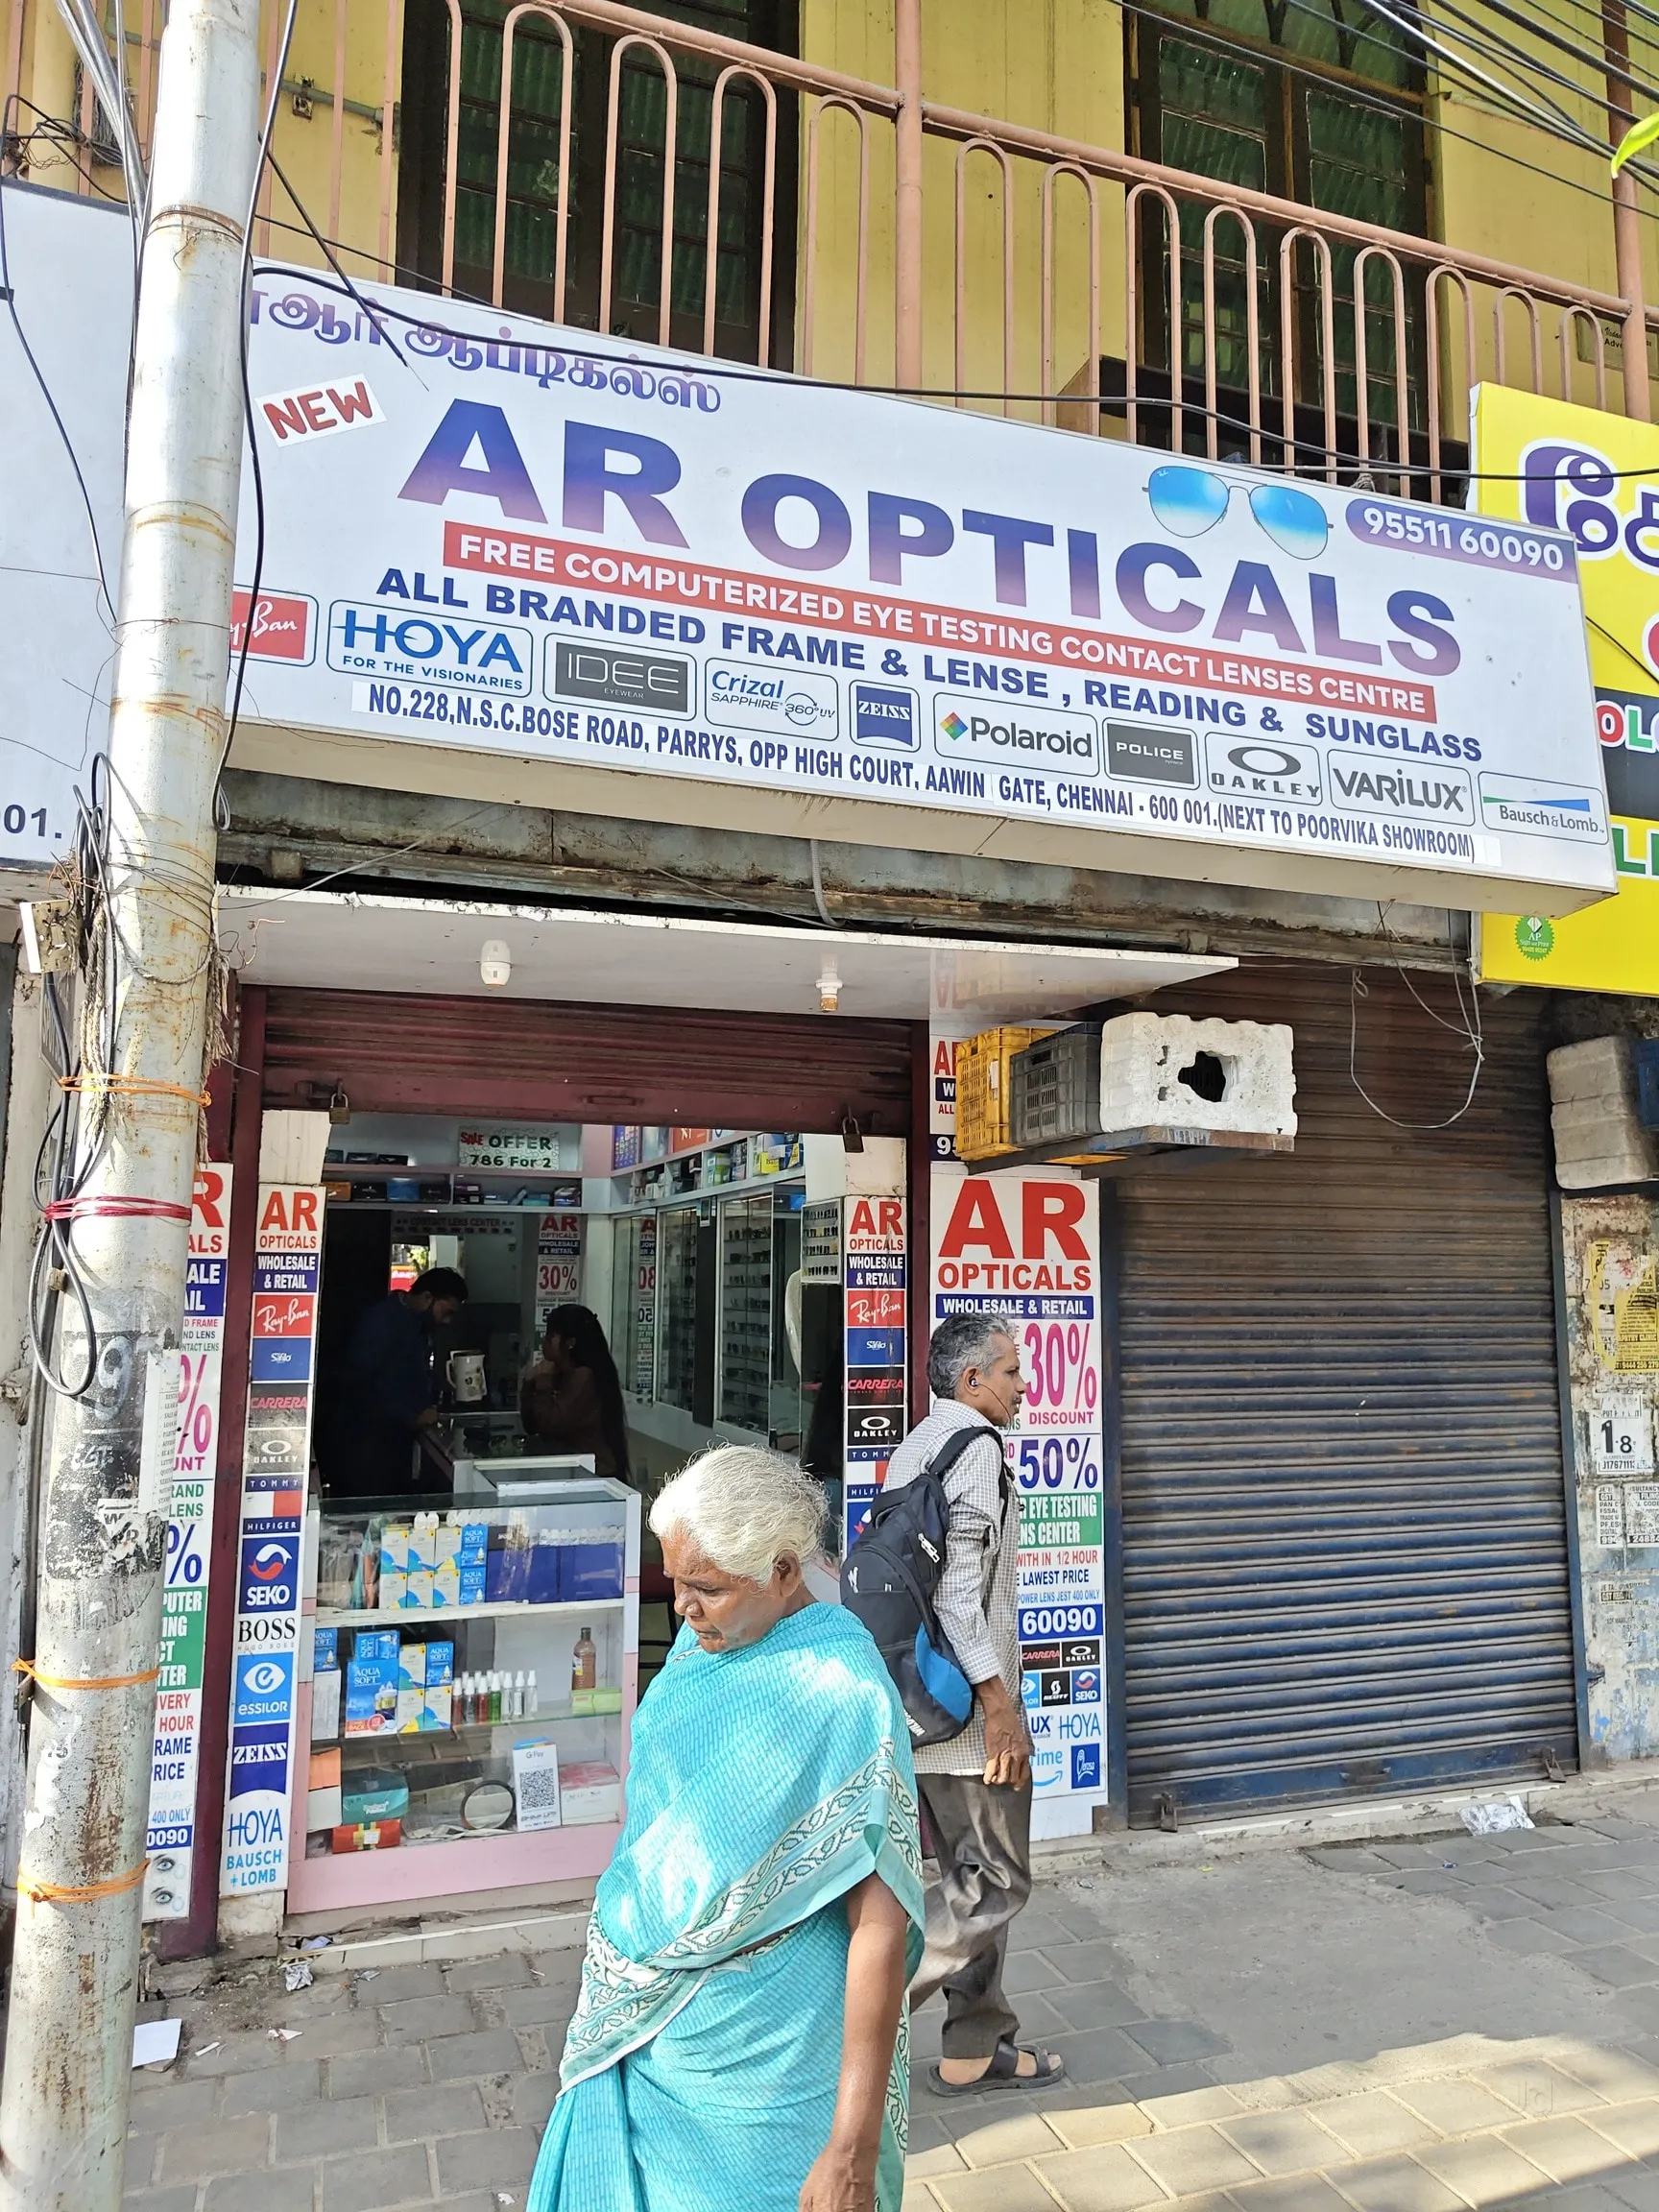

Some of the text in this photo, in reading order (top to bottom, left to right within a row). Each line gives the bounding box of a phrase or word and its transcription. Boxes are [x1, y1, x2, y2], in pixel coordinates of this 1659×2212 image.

[251, 291, 389, 345] ஆர்
[263, 380, 373, 441] NEW
[397, 397, 689, 549] AR
[742, 472, 1460, 676] OPTICALS
[1362, 506, 1563, 571] 95511 60090
[461, 534, 1426, 714] FREE COMPUTERIZED EYE TESTING CONTACT LENSES CENTRE
[331, 609, 524, 674] HOYA
[343, 655, 523, 690] FOR THE VISIONARIES
[376, 566, 469, 610] ALL
[486, 584, 706, 645] BRANDED
[722, 623, 866, 670] FRAME
[880, 648, 910, 678] &
[924, 655, 1049, 700] LENSE
[1084, 679, 1247, 727] READING
[1260, 707, 1284, 733] &
[1306, 713, 1481, 761] SUNGLASS
[566, 652, 680, 695] IDEE
[604, 686, 645, 700] EYEWEAR
[711, 670, 784, 699] Crizal
[710, 692, 780, 710] SAPPHIRE
[857, 701, 911, 722] ZEISS
[971, 716, 1093, 758] Polaroid
[1116, 741, 1184, 760] POLICE
[587, 714, 650, 753] ROAD,
[657, 726, 742, 767] PARRYS,
[750, 742, 788, 771] OPP
[796, 747, 843, 780] HIGH
[850, 754, 920, 791] COURT,
[926, 766, 985, 799] AAWIN
[998, 776, 1052, 811] GATE,
[1057, 782, 1134, 817] CHENNAI
[1149, 792, 1179, 823] 600
[1272, 808, 1293, 835] TO
[1297, 811, 1378, 847] POORVIKA
[1382, 824, 1476, 864] SHOWROOM)
[1211, 772, 1320, 799] OAKLEY
[488, 1135, 552, 1151] OFFER
[469, 1154, 552, 1168] 786 For 2
[260, 1191, 318, 1232] AR
[849, 1200, 903, 1236] AR
[938, 1179, 1092, 1261] AR
[541, 1214, 579, 1232] AR
[259, 1235, 317, 1249] OPTICALS
[849, 1238, 903, 1251] OPTICALS
[257, 1255, 316, 1271] WHOLESALE
[849, 1256, 903, 1270] WHOLESALE
[264, 1274, 307, 1289] & RETAIL
[539, 1265, 578, 1291] 30%
[856, 1271, 897, 1286] & RETAIL
[937, 1262, 1092, 1291] OPTICALS
[943, 1298, 1088, 1315] WHOLESALE & RETAIL
[192, 1318, 219, 1328] FRAME
[196, 1330, 216, 1339] LENS
[204, 1342, 220, 1352] LENS
[1024, 1323, 1096, 1409] 30%
[848, 1379, 903, 1390] CARRERA
[250, 1396, 307, 1409] CARRERA
[1029, 1411, 1094, 1425] DISCOUNT
[854, 1430, 898, 1438] OAKLEY
[253, 1455, 299, 1464] OAKLEY
[1019, 1437, 1098, 1489] 50%
[251, 1478, 300, 1488] TOMMY
[1029, 1495, 1097, 1519] EYE TESTING
[248, 1520, 298, 1531] HILFIGER
[1038, 1521, 1081, 1545] CENTER
[1016, 1550, 1098, 1567] WITH IN 1/2 HOUR
[1022, 1569, 1090, 1586] LAWEST PRICE
[1018, 1593, 1039, 1604] POWER
[1040, 1592, 1055, 1602] LENS
[1072, 1589, 1084, 1601] 400
[1085, 1589, 1100, 1600] ONLY
[238, 1617, 296, 1644] BOSS
[1022, 1607, 1096, 1636] 60090
[1022, 1649, 1061, 1661] CARRERA
[353, 1675, 377, 1685] SOFT
[354, 1667, 381, 1678] AQUA
[159, 1715, 194, 1732] HOUR
[1057, 1712, 1101, 1740] HOYA
[155, 1737, 192, 1756] RAME
[232, 1742, 287, 1765] ZEISS
[154, 1763, 185, 1781] RICE
[169, 1808, 191, 1822] ONLY
[227, 1808, 283, 1848] HOYA
[227, 1849, 282, 1870] BAUSCH
[241, 1871, 276, 1887] LOMB
